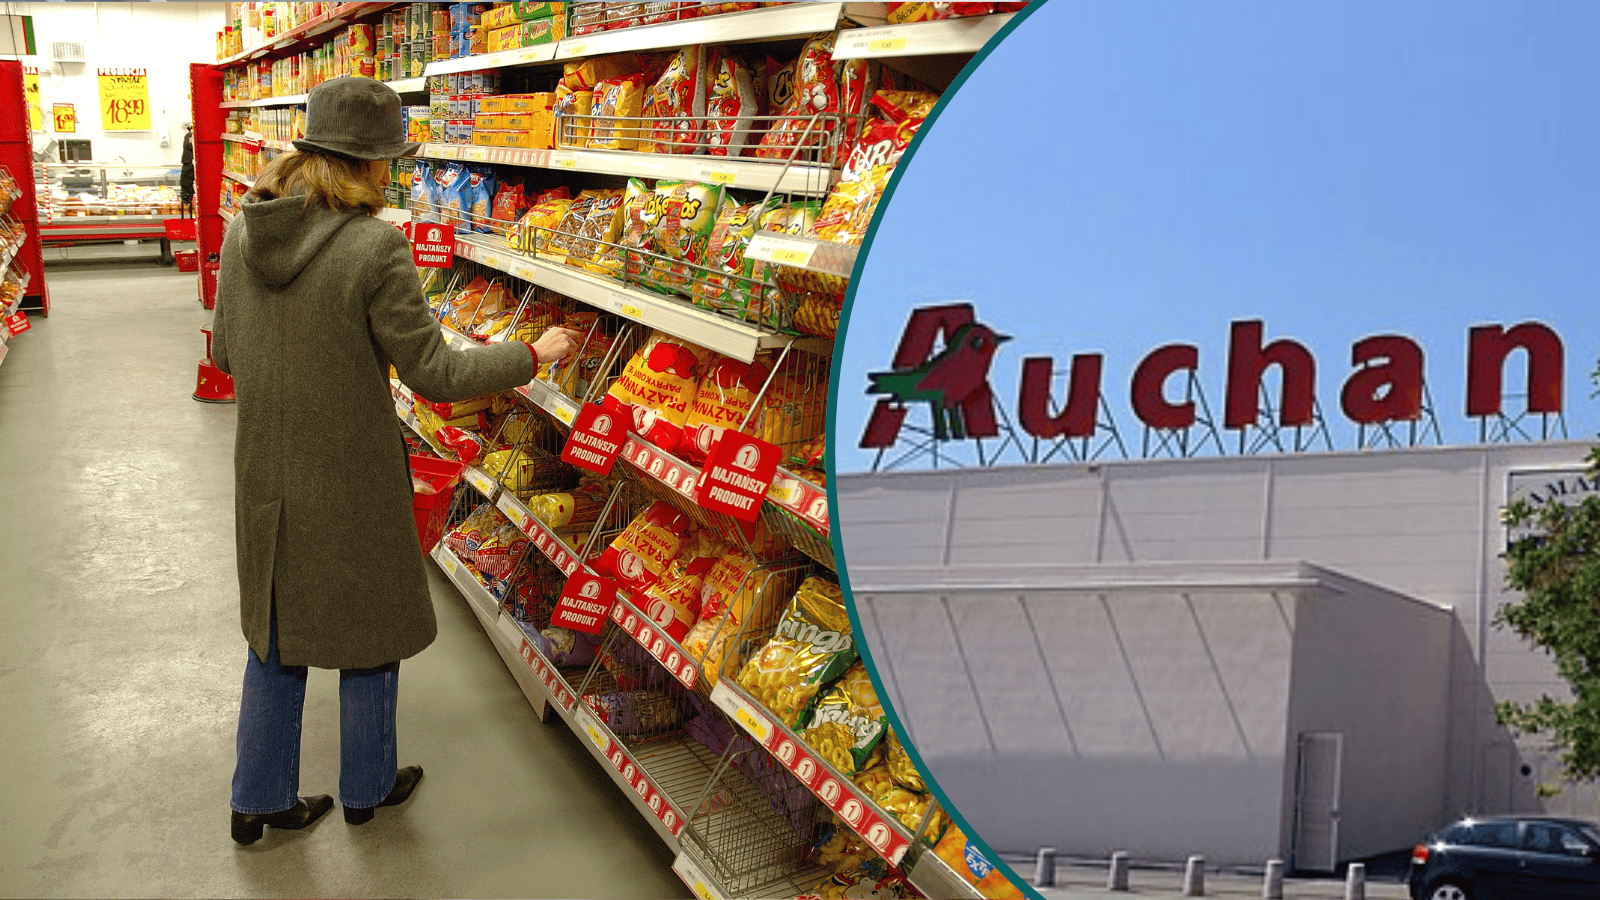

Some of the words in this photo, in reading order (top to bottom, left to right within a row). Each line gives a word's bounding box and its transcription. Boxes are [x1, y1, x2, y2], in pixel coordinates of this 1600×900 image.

[415, 243, 452, 253] NAJTAŃSZY
[418, 254, 448, 263] PRODUKT
[859, 302, 1565, 449] Auchan
[699, 389, 752, 411] PAPRKOWE
[571, 430, 618, 454] NAJTAŃSZY
[570, 445, 608, 467] PRODUKT
[710, 465, 768, 495] NAJTAŃSZY
[708, 485, 755, 511] PRODUKT
[560, 596, 608, 615] NAJTAŃSZY
[559, 610, 598, 627] PRODUKT
